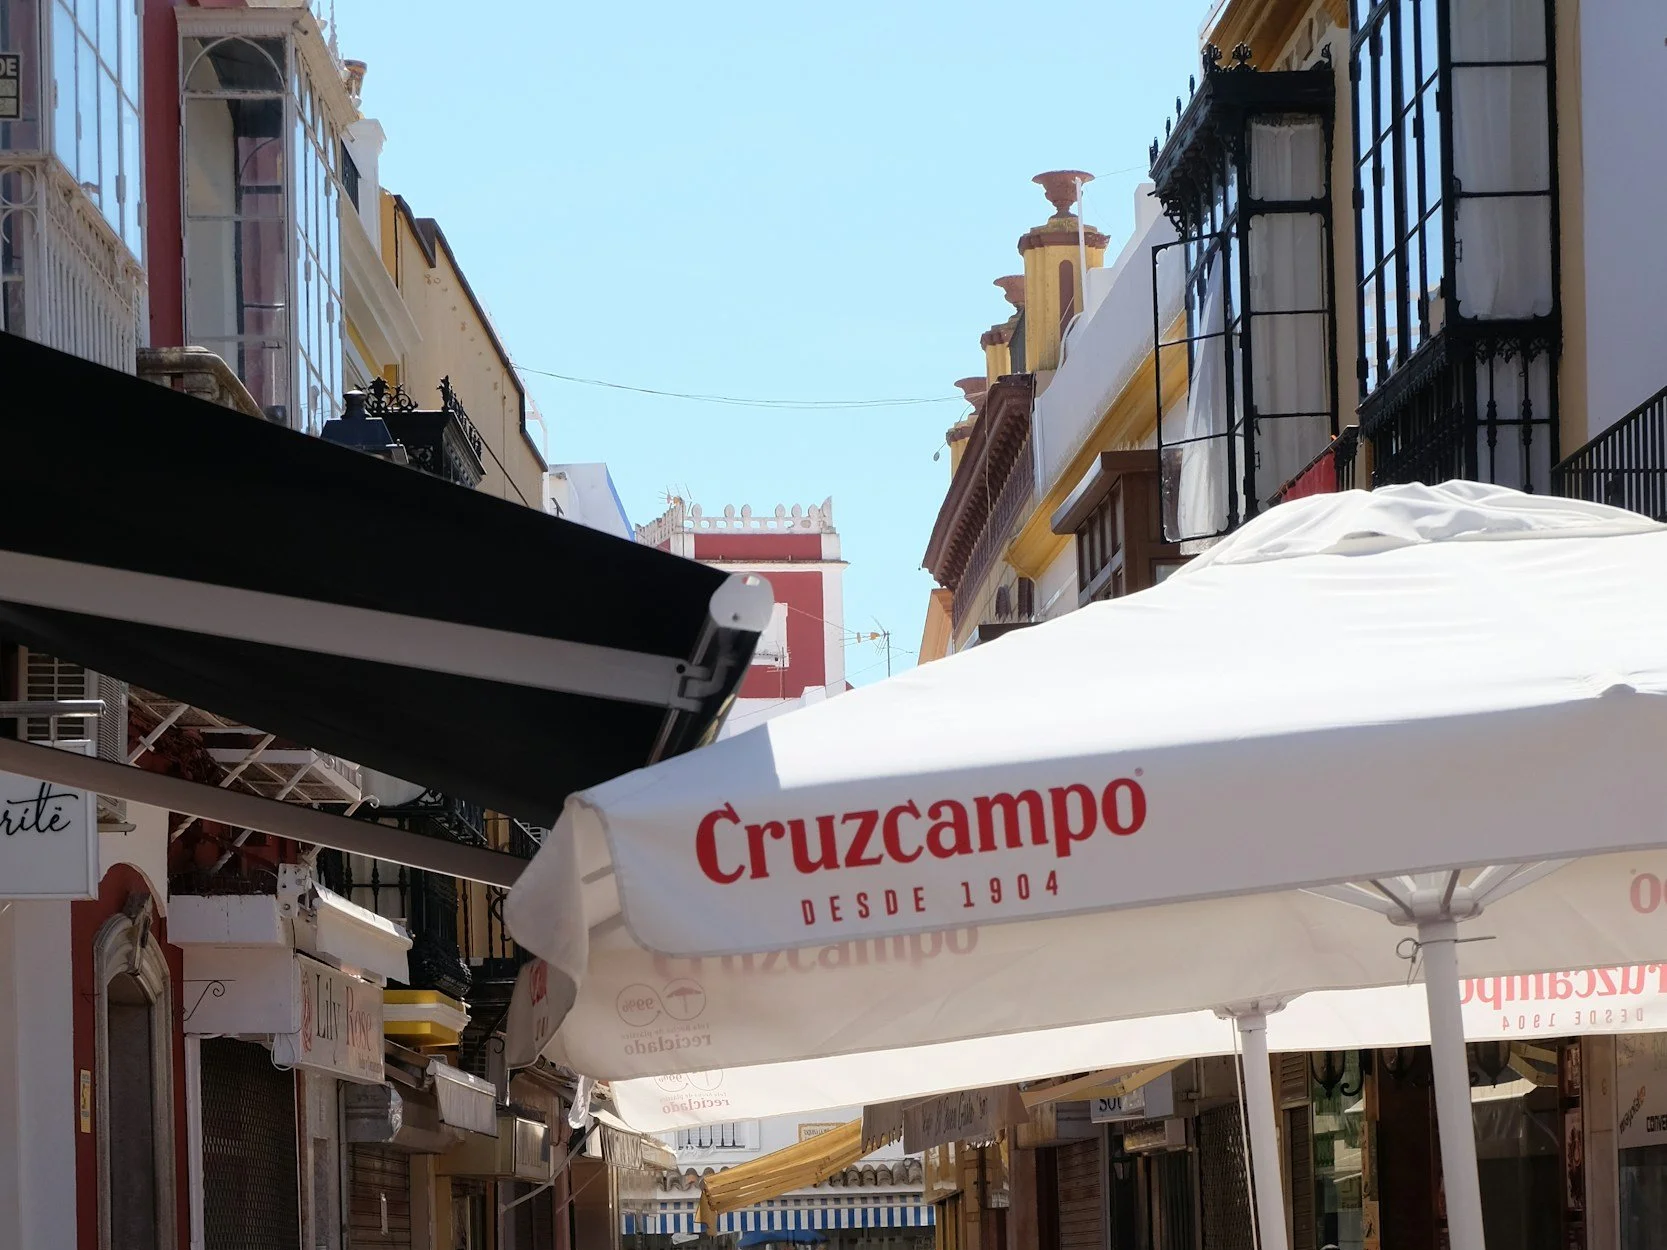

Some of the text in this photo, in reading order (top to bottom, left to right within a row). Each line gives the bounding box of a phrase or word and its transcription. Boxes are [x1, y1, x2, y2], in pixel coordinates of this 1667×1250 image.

[695, 778, 1148, 885] Cruzcampo
[801, 870, 1059, 926] DESDE 1904
[316, 974, 372, 1065] Lily Rose
